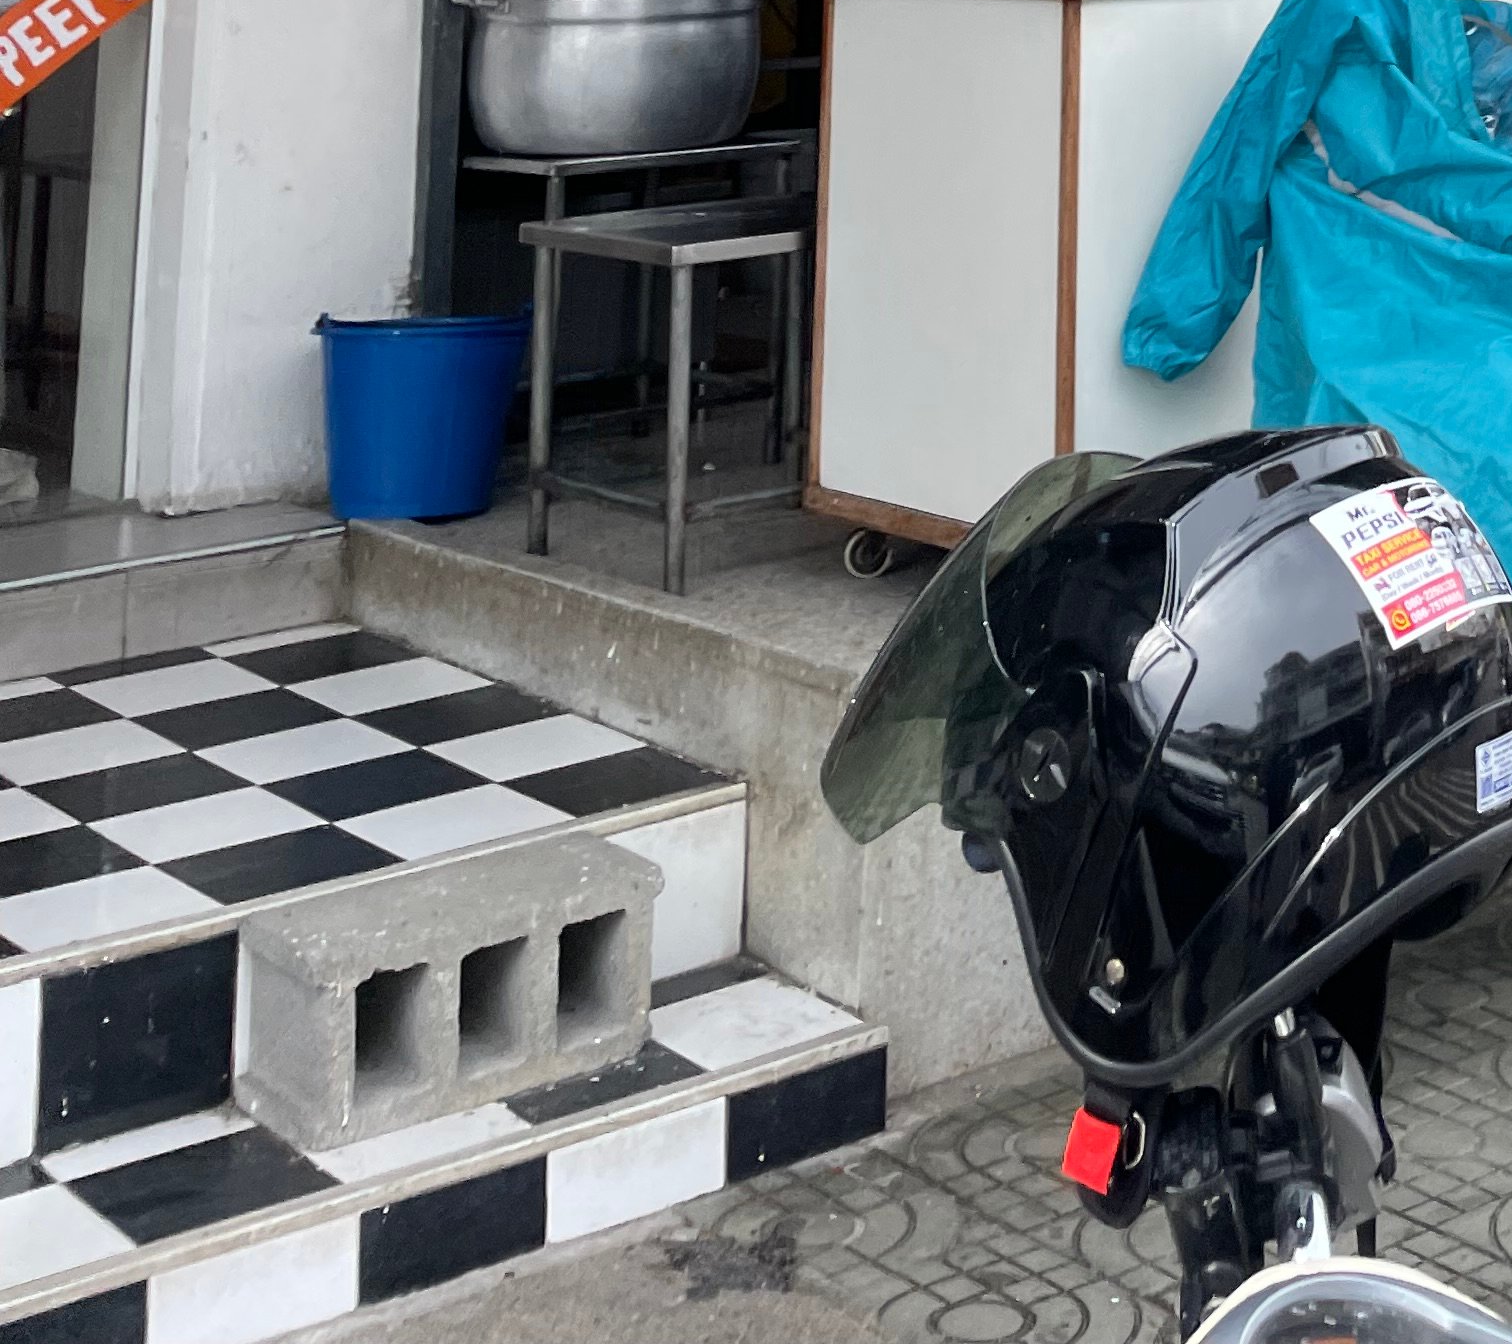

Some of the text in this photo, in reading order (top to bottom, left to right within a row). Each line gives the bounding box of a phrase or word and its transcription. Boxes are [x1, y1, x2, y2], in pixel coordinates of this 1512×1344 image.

[1346, 505, 1375, 522] Mr.
[1341, 511, 1404, 549] PEPSI
[1355, 547, 1381, 566] TAXI
